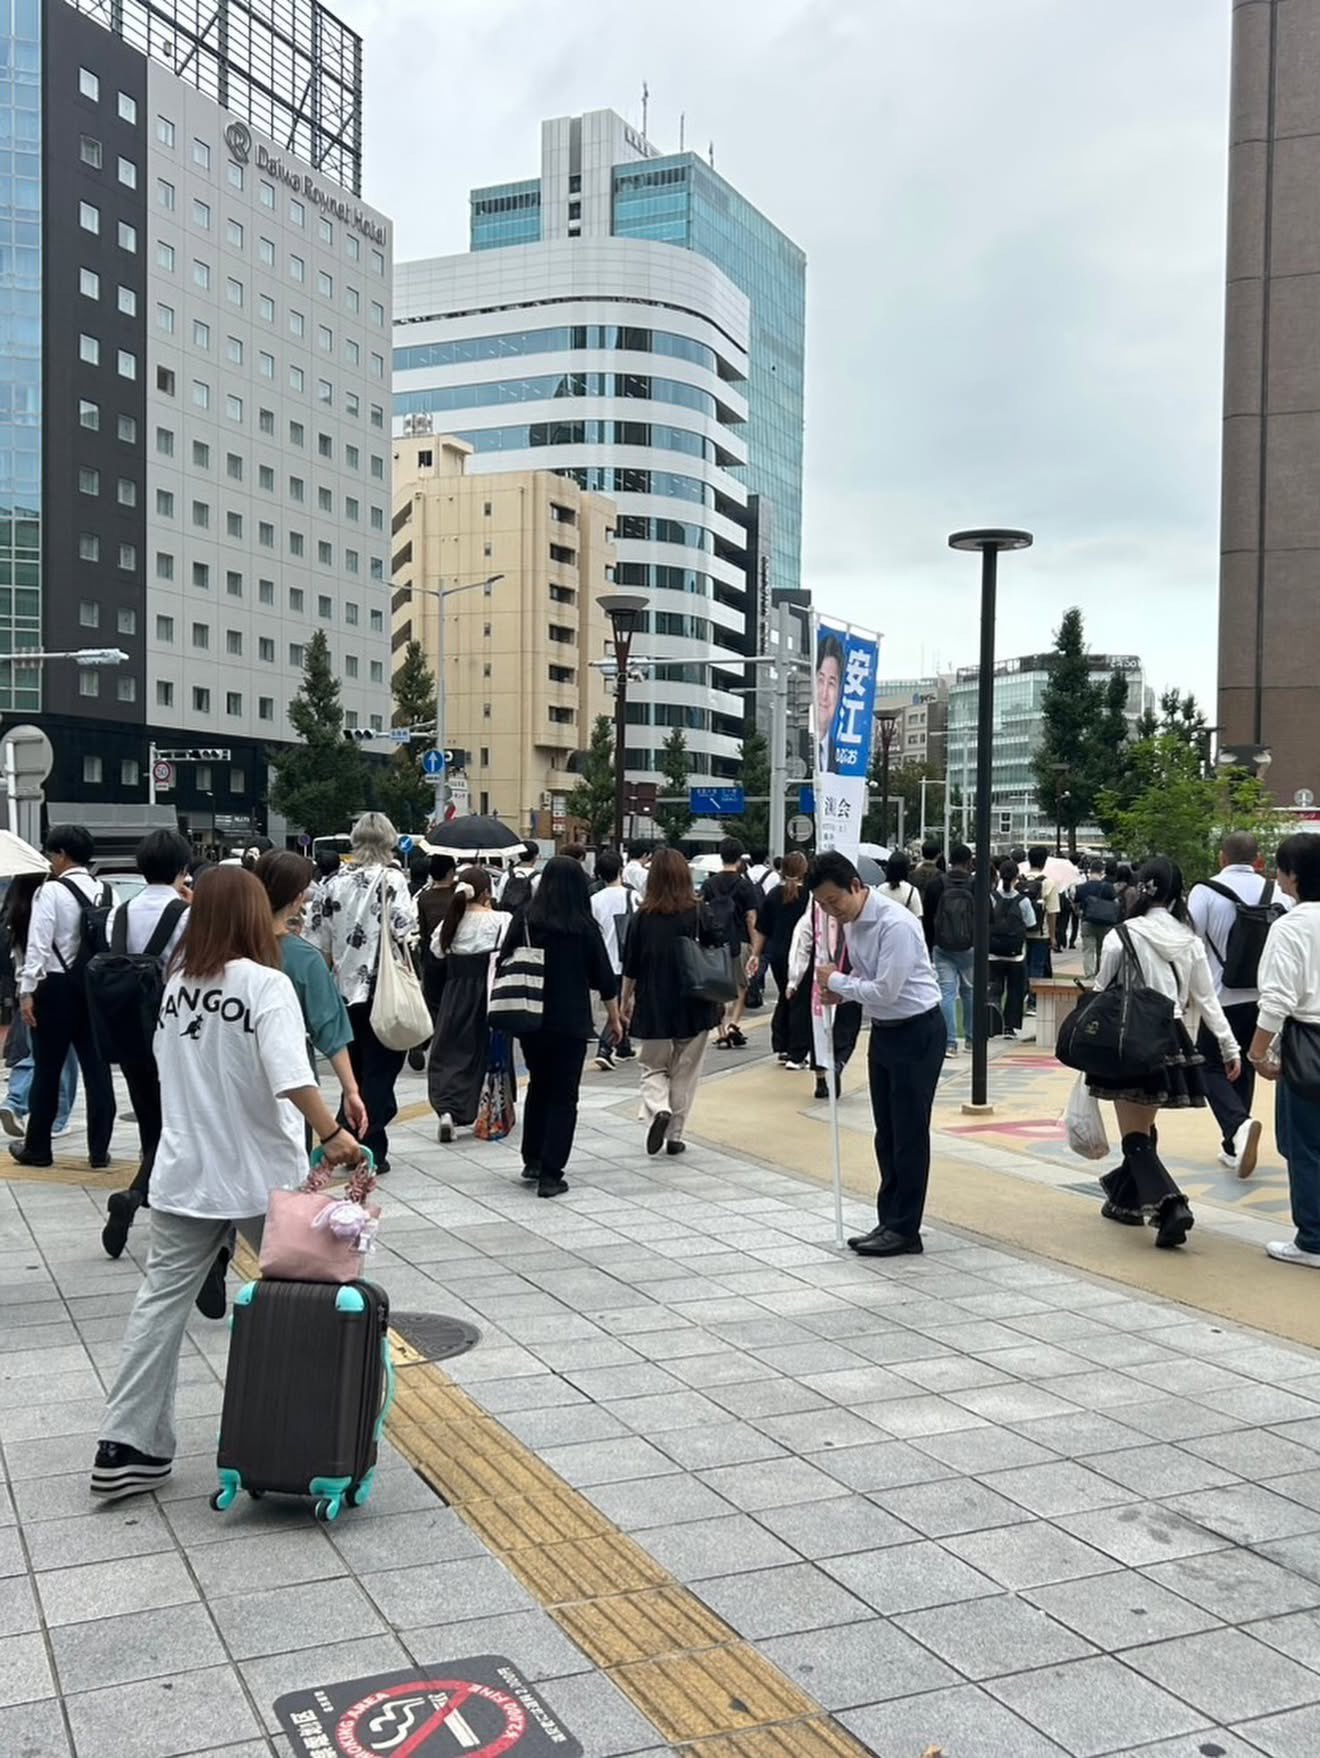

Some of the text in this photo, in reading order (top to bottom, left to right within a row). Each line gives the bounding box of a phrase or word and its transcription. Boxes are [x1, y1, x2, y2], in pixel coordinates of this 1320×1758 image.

[255, 145, 387, 246] Daiwa Roynet Hotel
[837, 649, 870, 744] 安江
[467, 1684, 510, 1703] FINE
